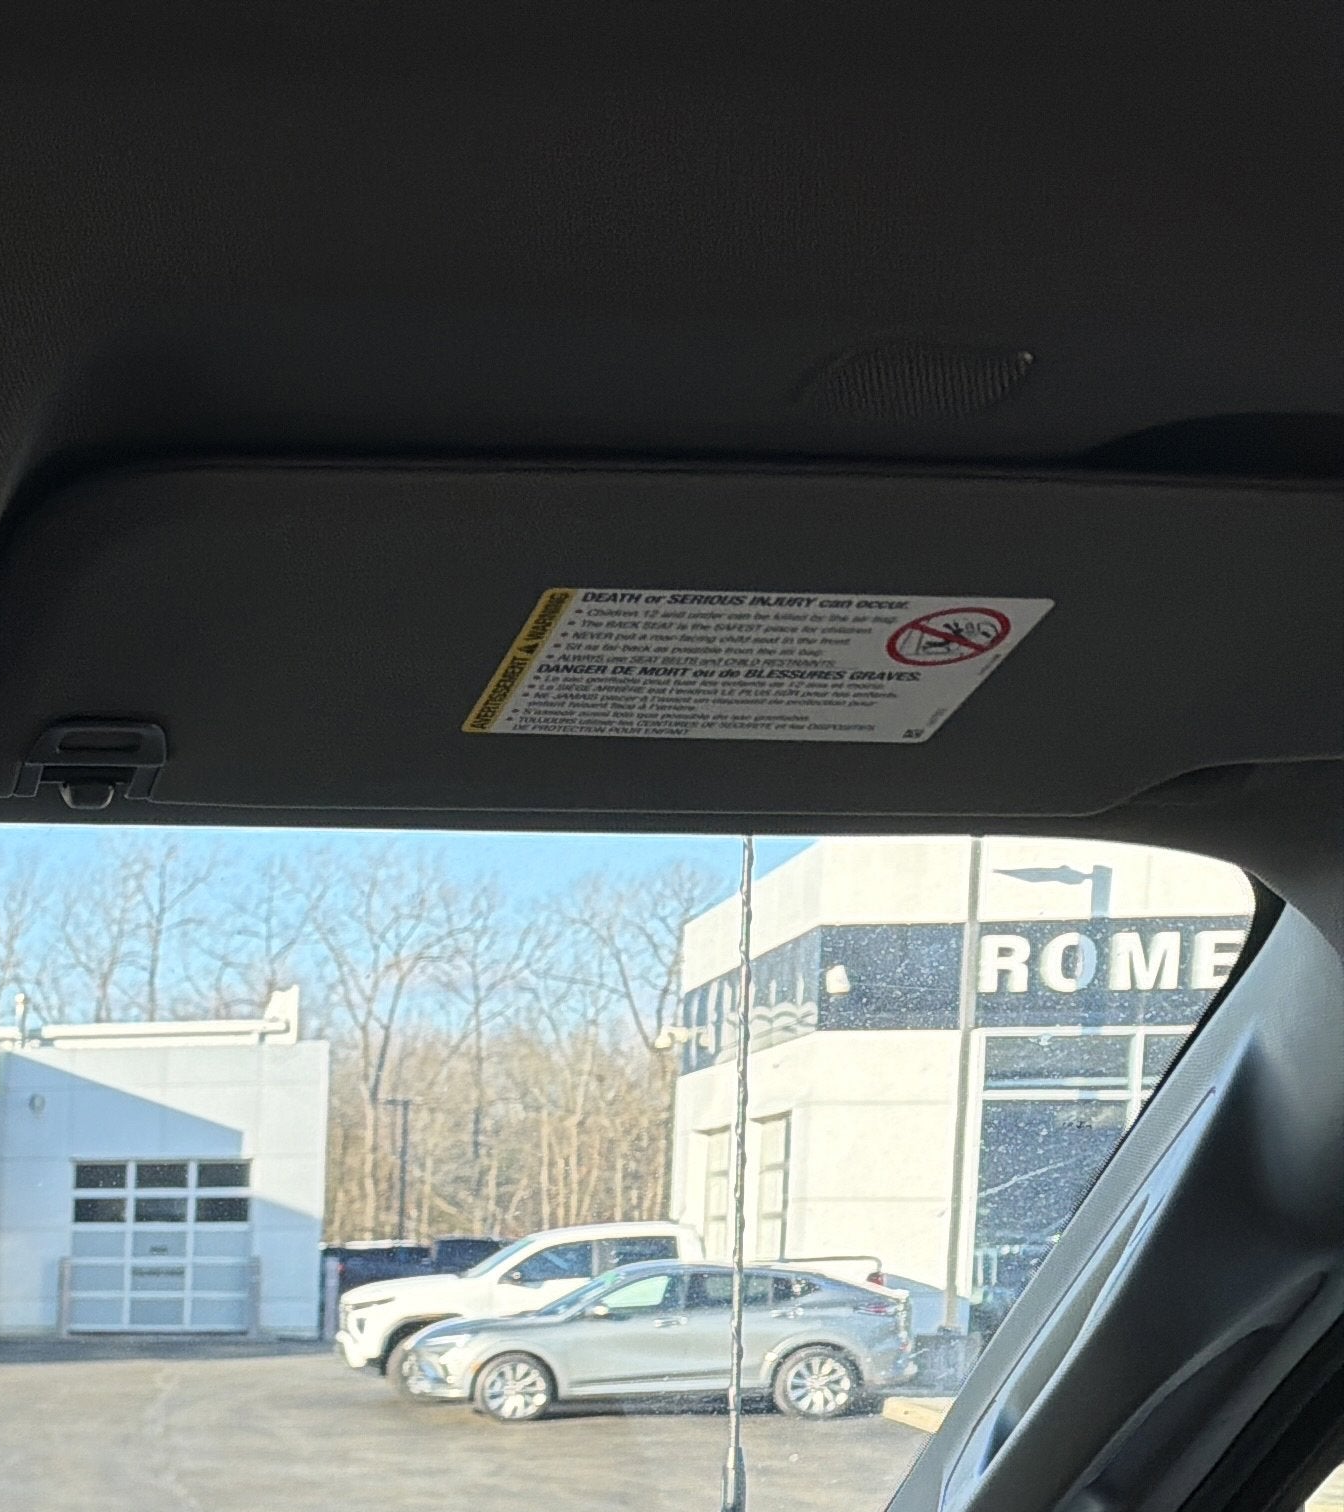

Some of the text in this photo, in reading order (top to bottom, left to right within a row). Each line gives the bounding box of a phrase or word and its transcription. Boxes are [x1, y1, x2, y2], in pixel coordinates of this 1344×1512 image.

[582, 592, 910, 610] DEATH or SERIOUS INJURY can occur.
[527, 592, 570, 642] WARNING
[537, 664, 921, 681] DANGER DE MORT ou de BLESSURES GRAVES.
